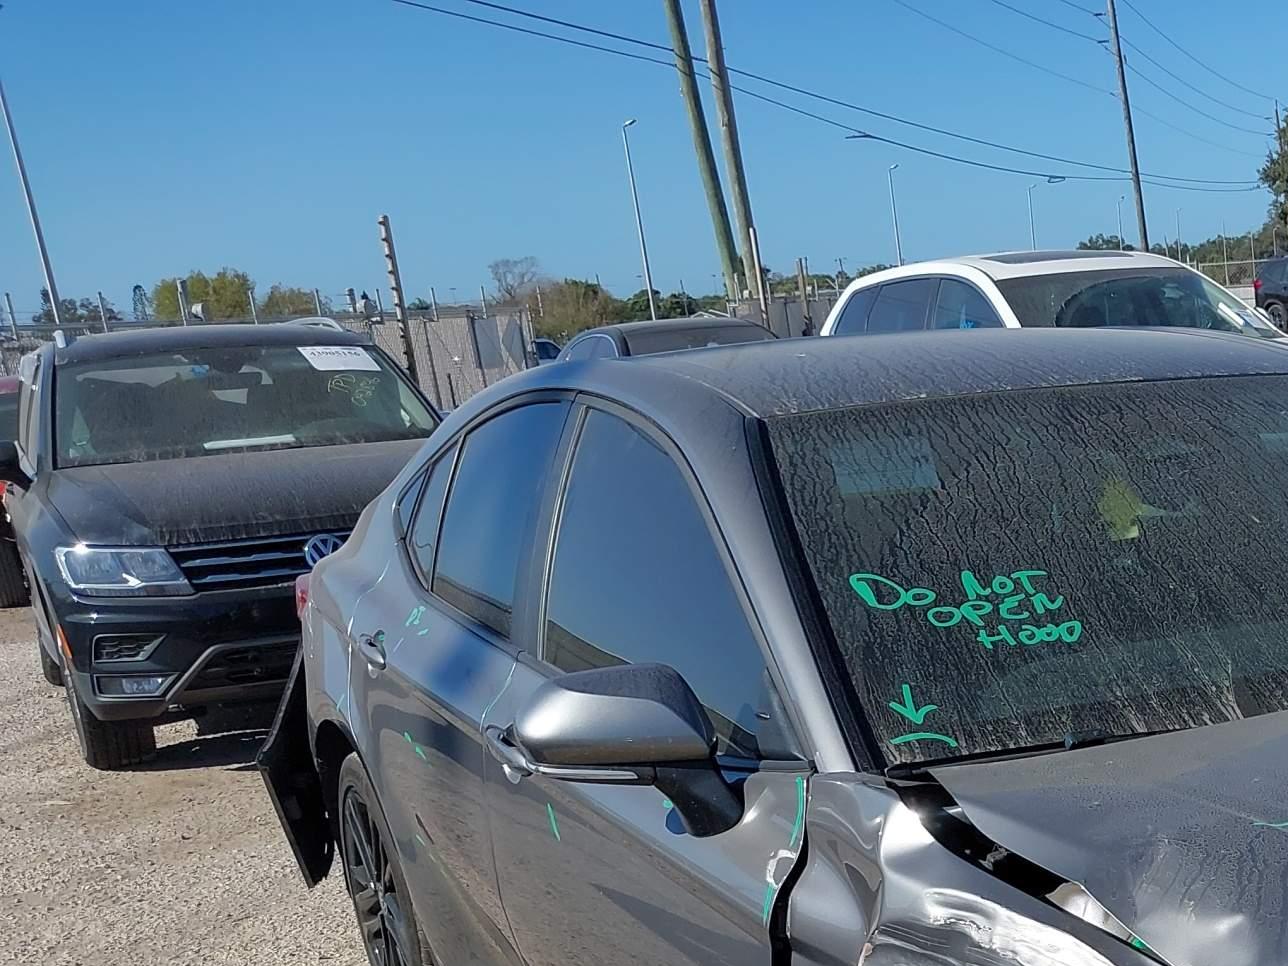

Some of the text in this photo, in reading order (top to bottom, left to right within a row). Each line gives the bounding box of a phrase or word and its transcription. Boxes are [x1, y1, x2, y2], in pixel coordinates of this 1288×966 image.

[849, 570, 1048, 610] Do NOT
[927, 593, 1065, 628] OPEN
[977, 620, 1082, 650] HOOD
